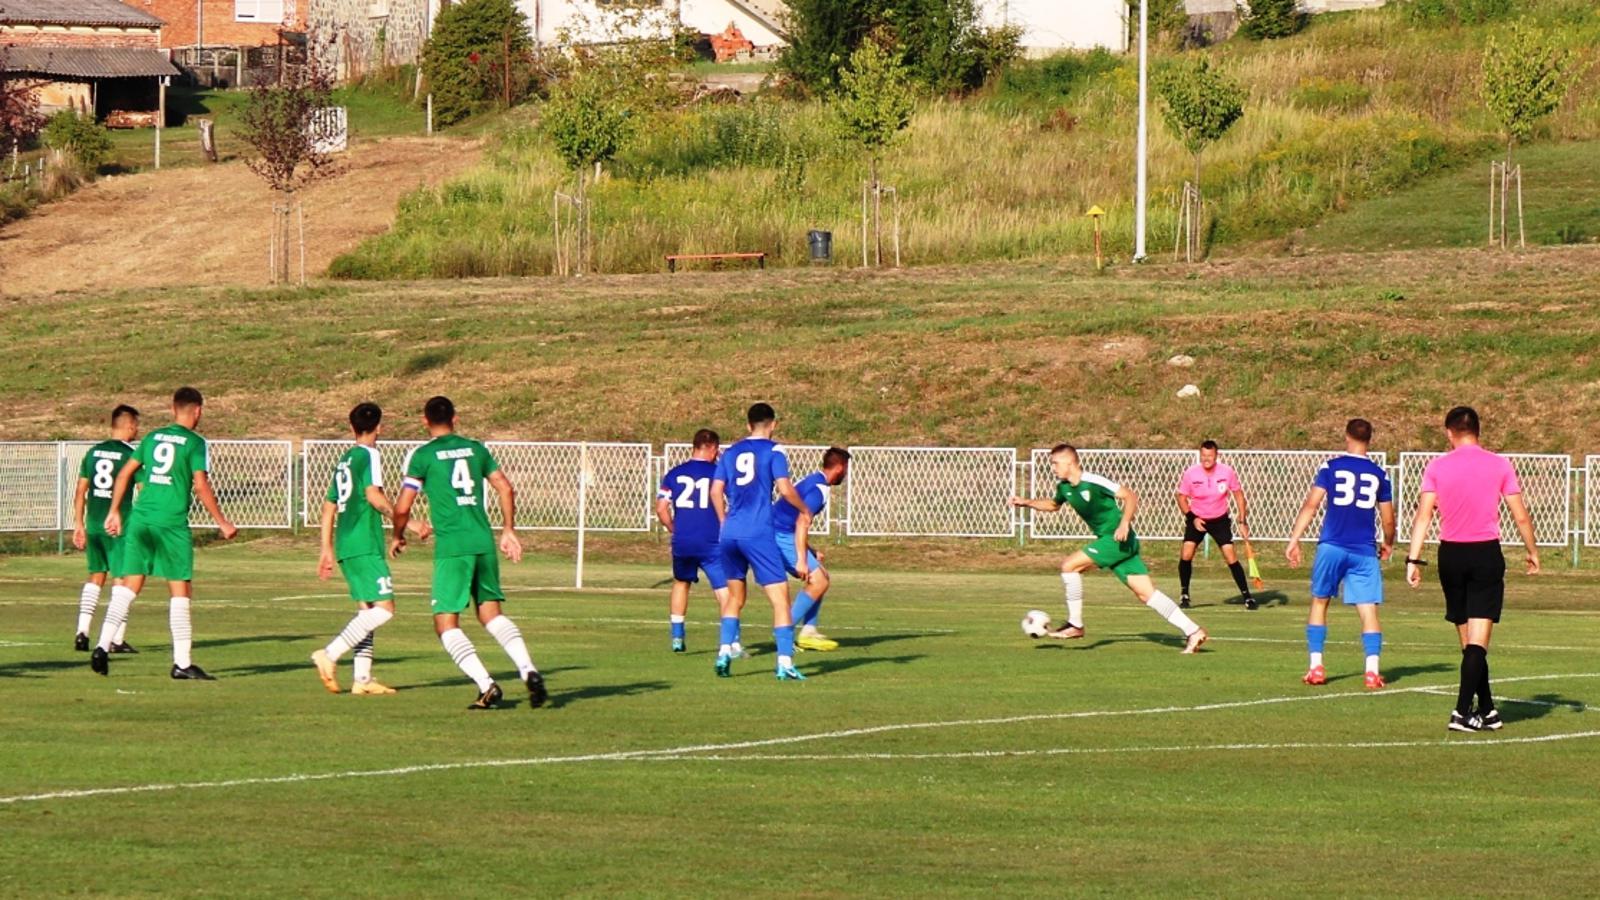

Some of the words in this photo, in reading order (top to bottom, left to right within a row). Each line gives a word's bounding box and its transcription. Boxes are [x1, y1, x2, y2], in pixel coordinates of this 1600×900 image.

[93, 459, 114, 489] 8
[152, 442, 175, 475] 9
[736, 452, 755, 486] 9
[451, 459, 475, 495] 4
[675, 475, 710, 509] 21
[1333, 470, 1380, 509] 33
